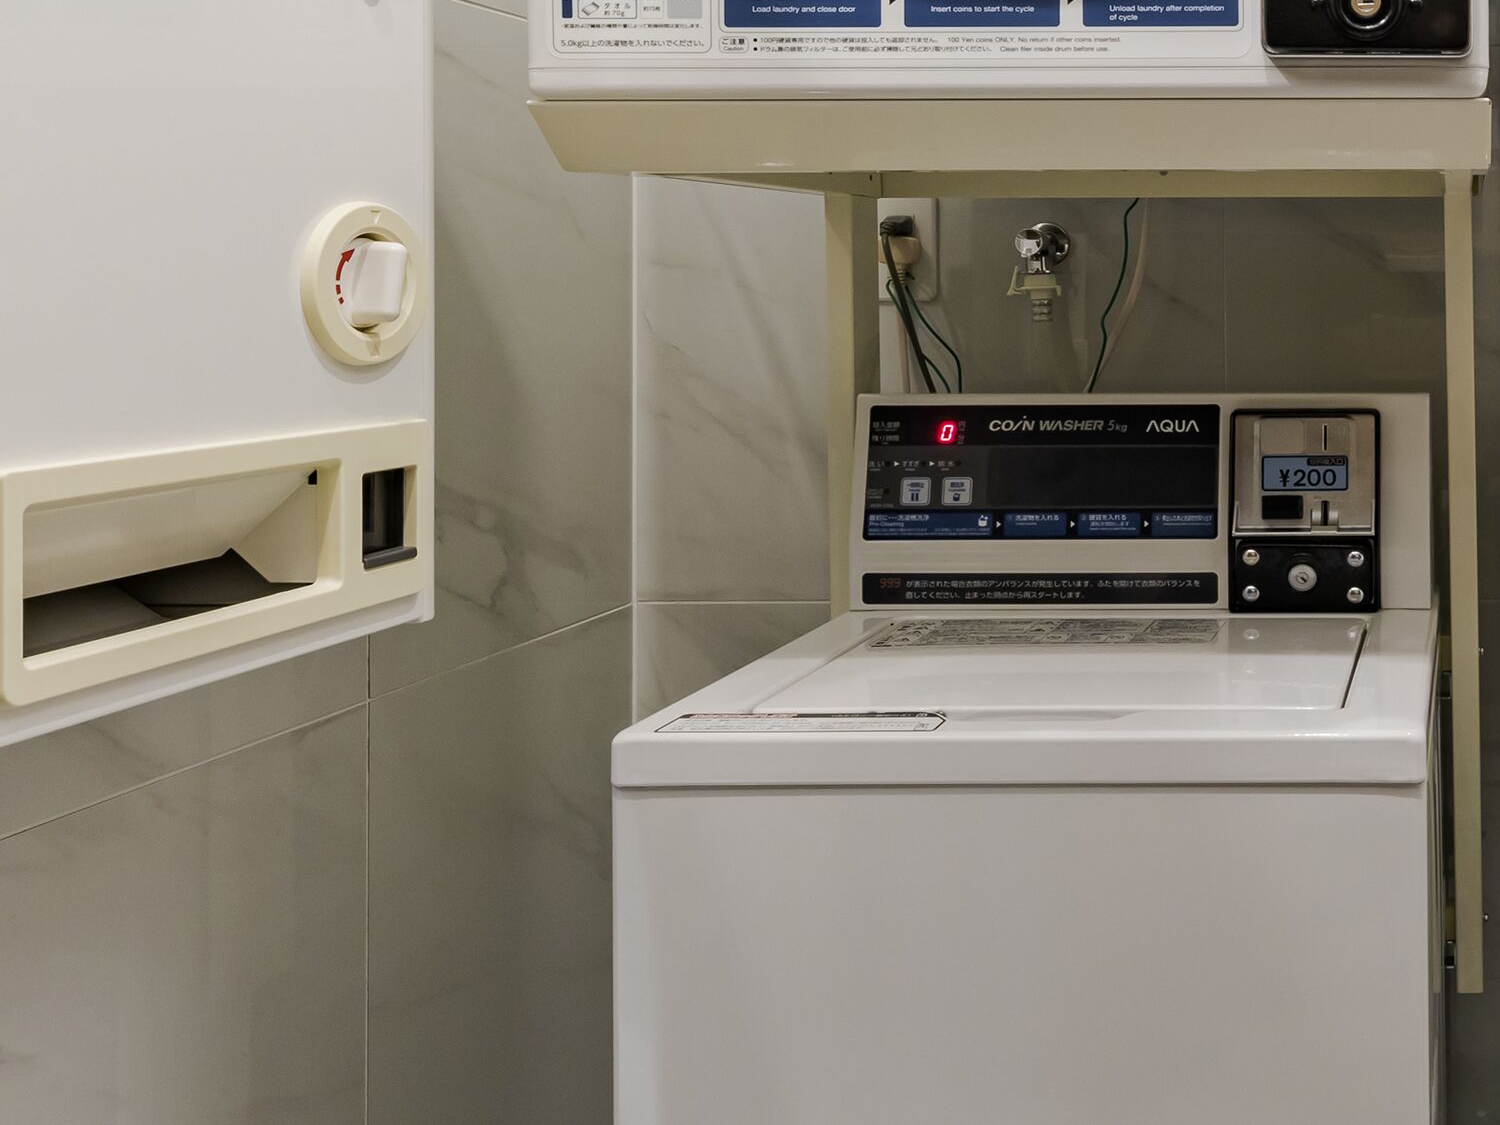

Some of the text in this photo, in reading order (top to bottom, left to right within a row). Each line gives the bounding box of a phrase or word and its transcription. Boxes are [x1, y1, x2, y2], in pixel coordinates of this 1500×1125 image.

[773, 6, 799, 14] laundry
[1015, 6, 1034, 14] cycle
[1137, 5, 1164, 13] laundry
[1184, 5, 1224, 13] completion
[1118, 14, 1138, 22] cycle
[721, 37, 746, 46] ご注意
[1039, 420, 1104, 431] WASHER
[1107, 420, 1128, 433] 5kg
[1146, 420, 1199, 433] AQUA
[940, 424, 954, 442] 0
[1280, 469, 1336, 487] ¥200
